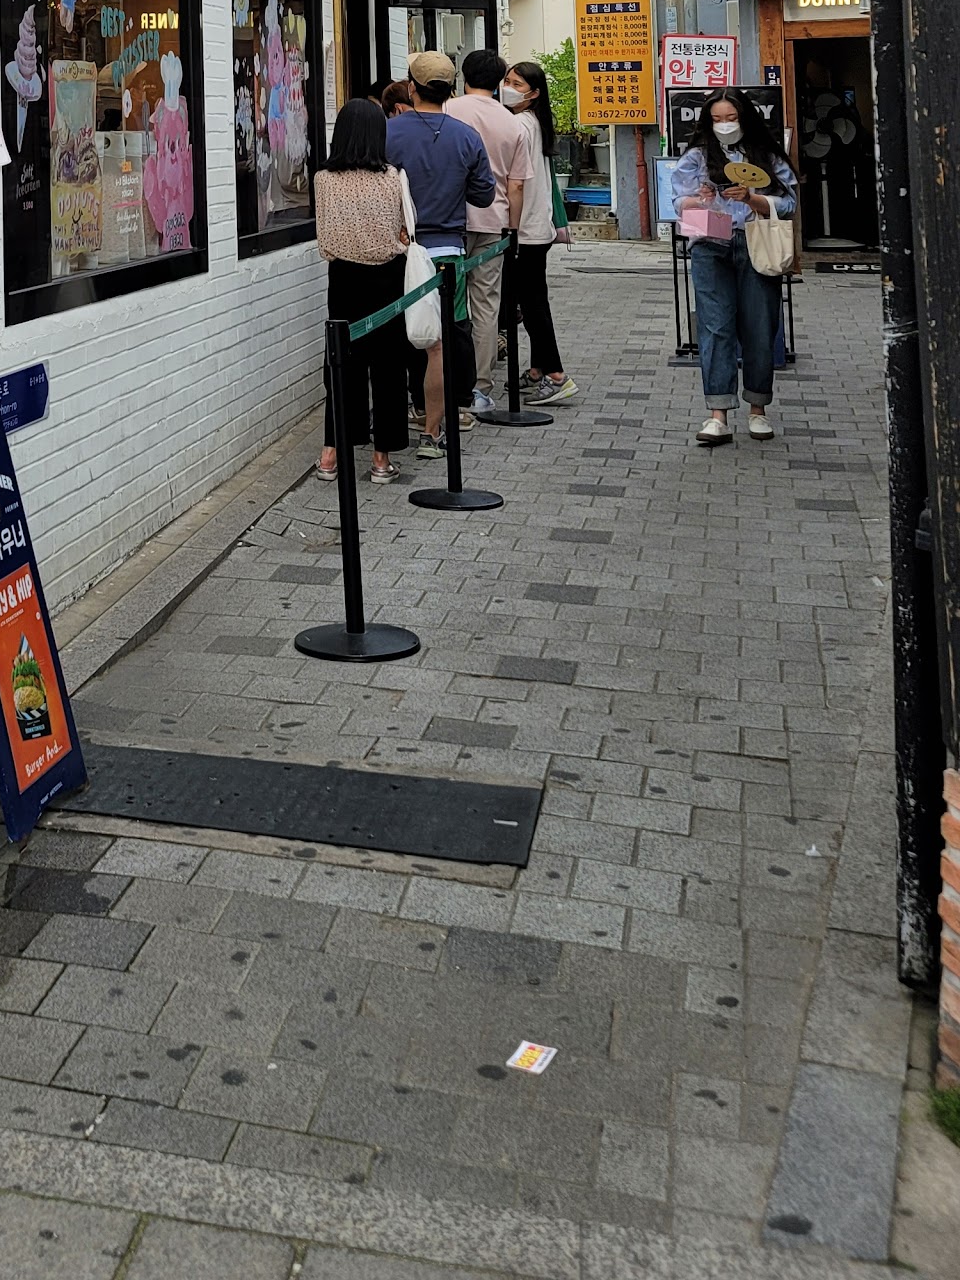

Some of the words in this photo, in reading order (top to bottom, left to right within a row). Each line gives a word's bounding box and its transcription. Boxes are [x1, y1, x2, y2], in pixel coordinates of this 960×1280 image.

[100, 5, 126, 38] BEST
[671, 43, 729, 56] 전통한정식
[587, 109, 647, 118] 02)3672-7070
[16, 573, 33, 603] HIP
[25, 753, 45, 778] Burger
